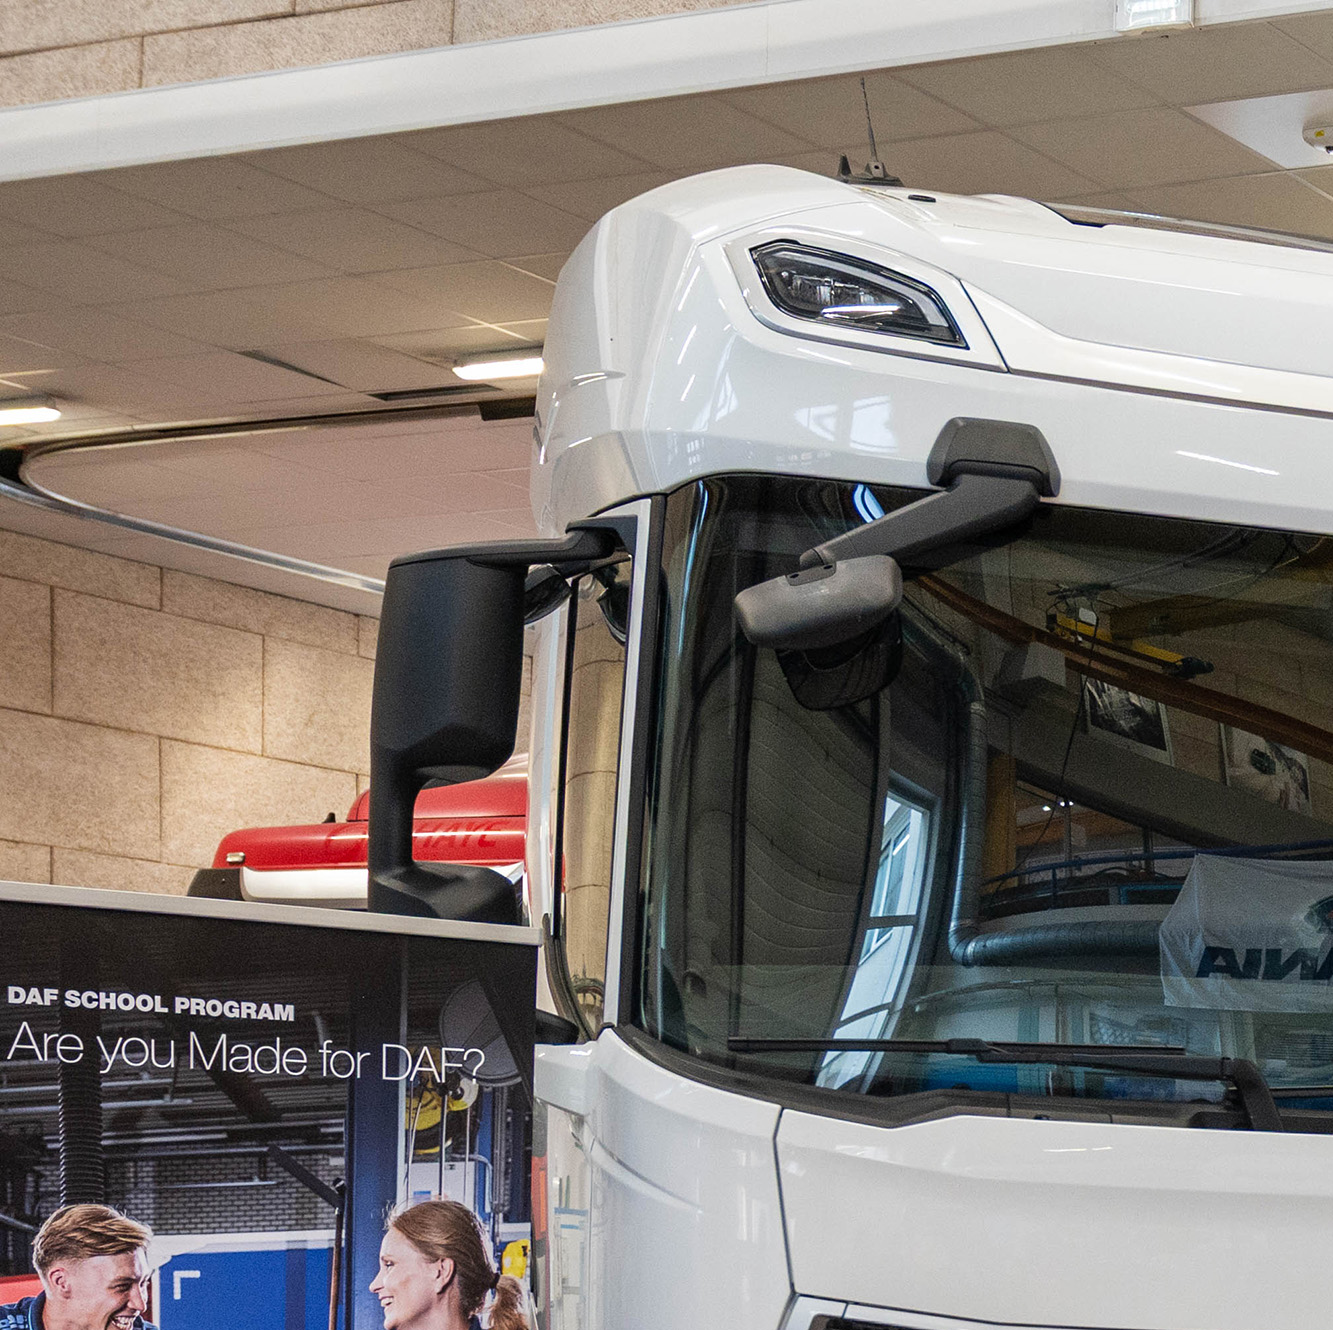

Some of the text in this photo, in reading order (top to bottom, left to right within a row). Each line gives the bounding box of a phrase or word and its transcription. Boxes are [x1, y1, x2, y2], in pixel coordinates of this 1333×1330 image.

[7, 986, 295, 1021] DAF SCHOOL PROGRAM
[7, 1021, 486, 1085] Are you Made for DAF?
